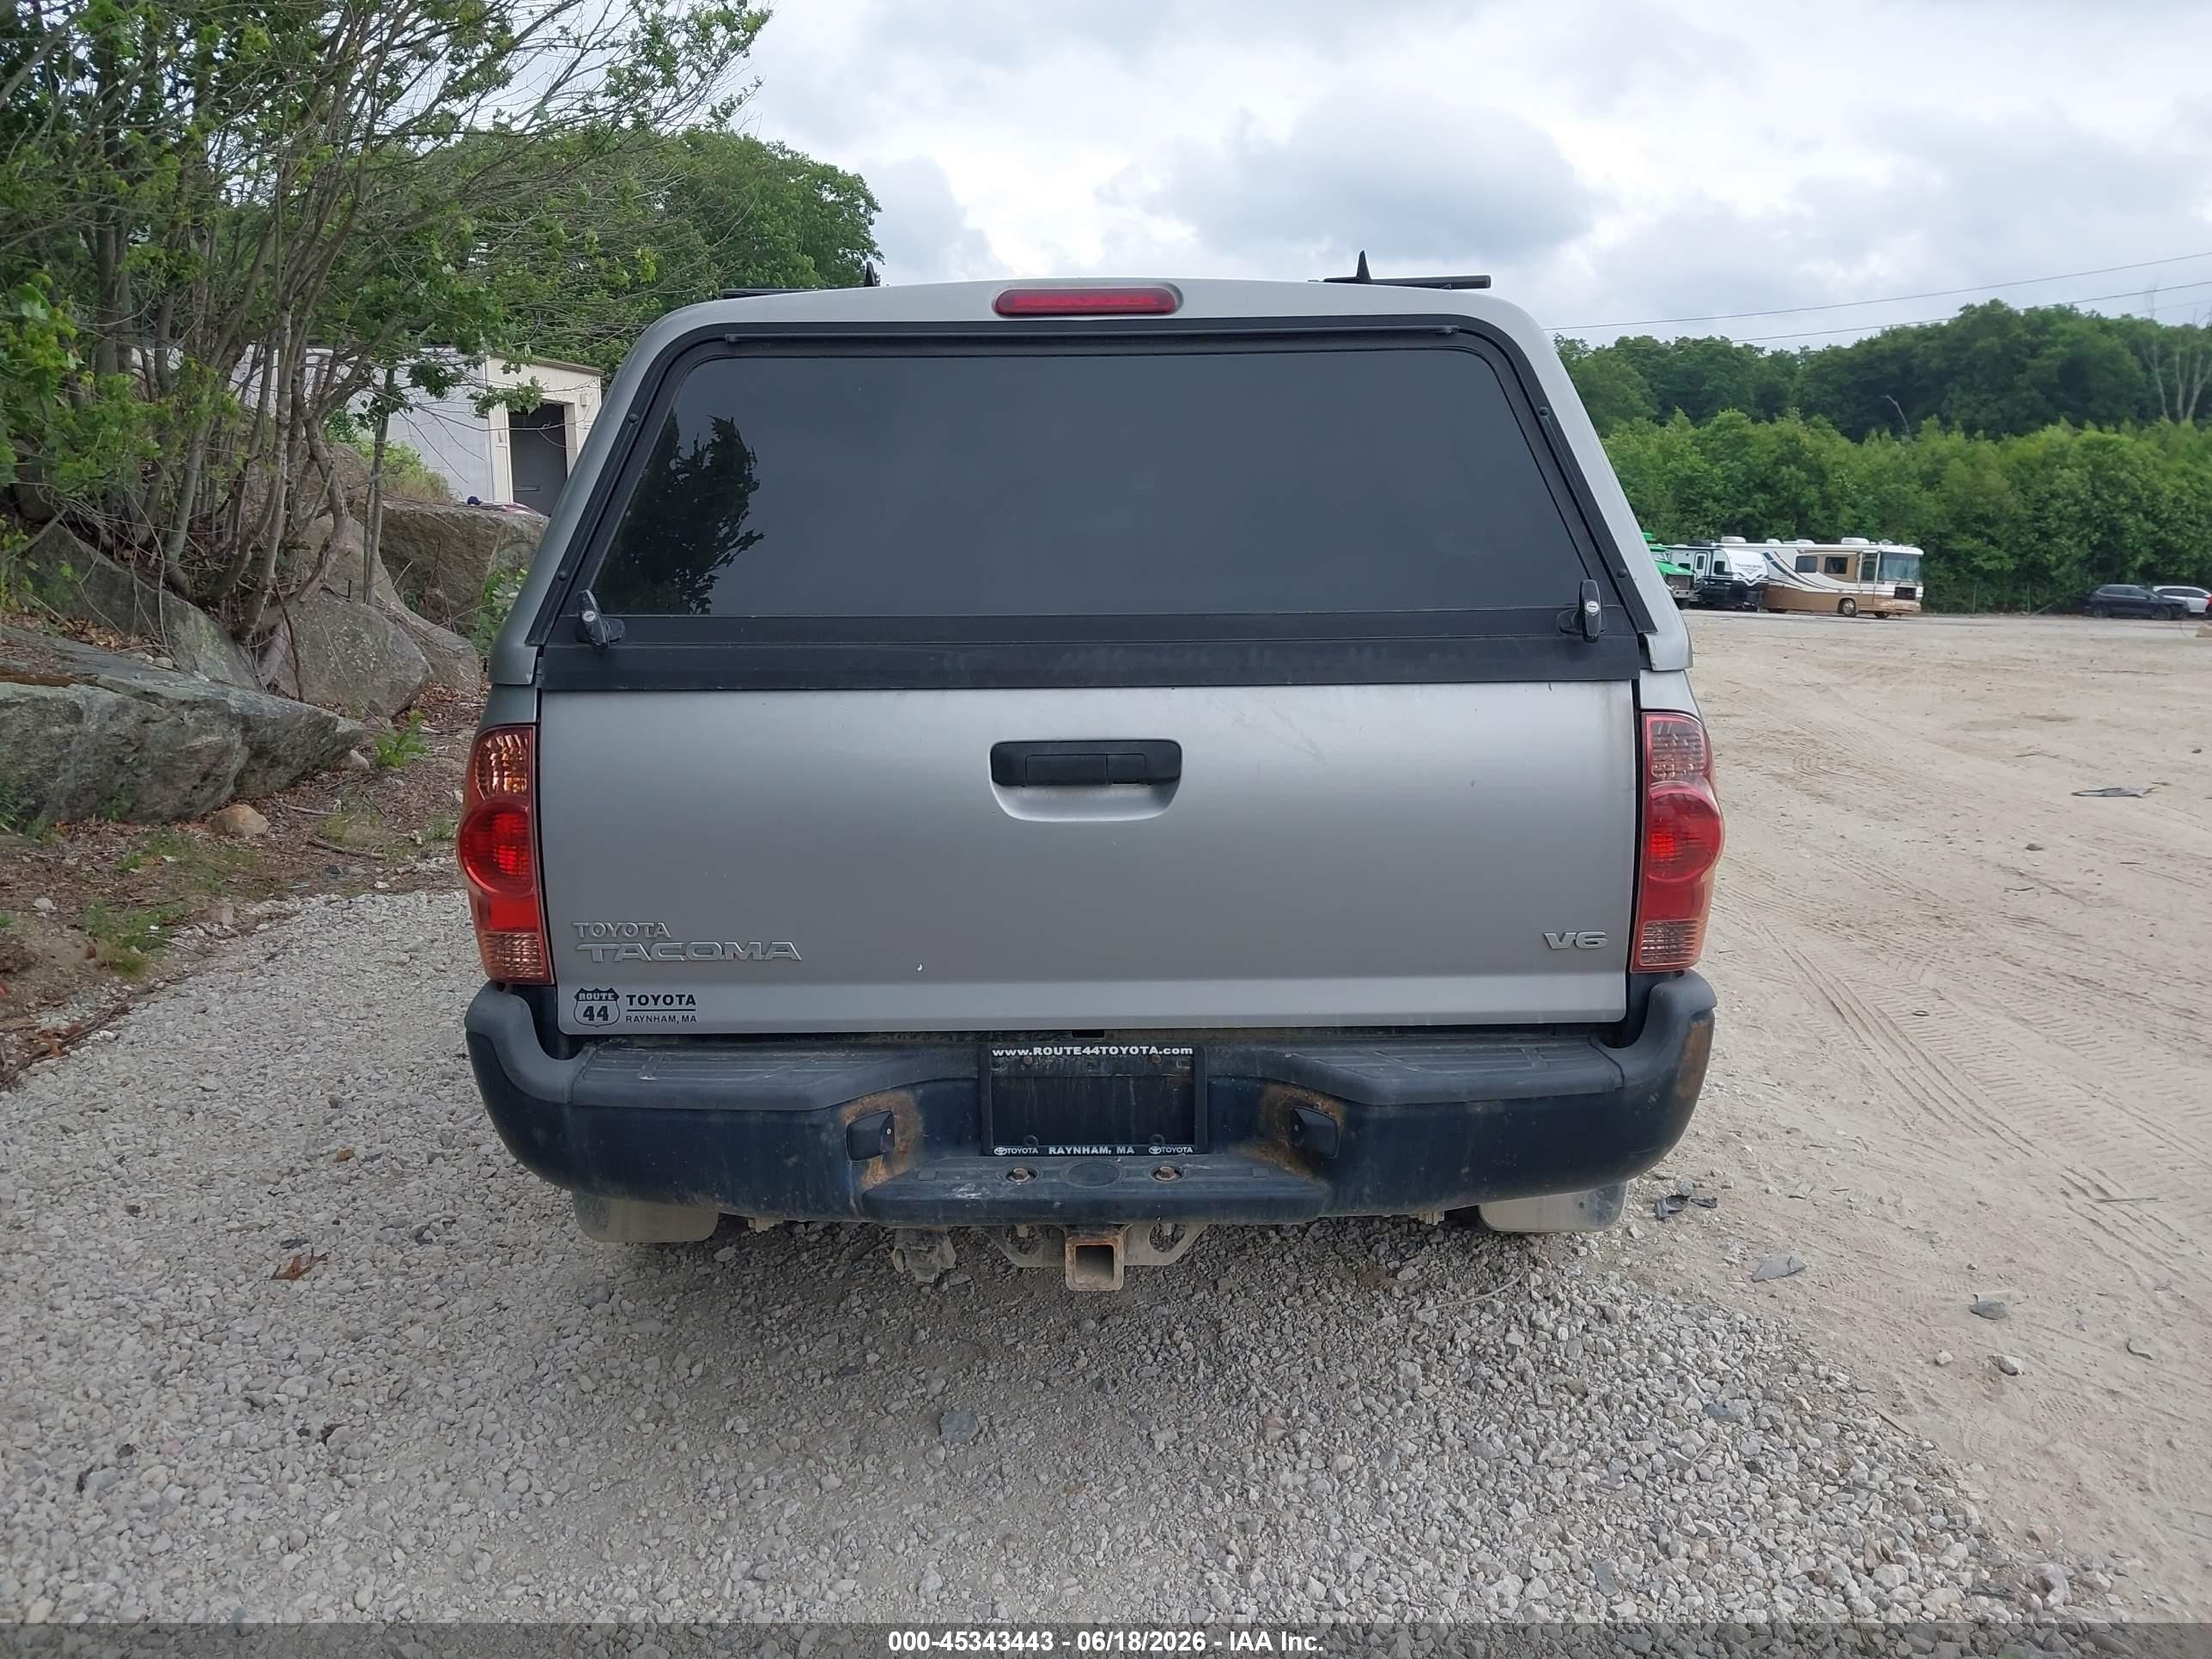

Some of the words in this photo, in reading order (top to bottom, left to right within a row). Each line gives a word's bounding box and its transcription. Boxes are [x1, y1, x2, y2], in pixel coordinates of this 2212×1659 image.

[572, 921, 672, 939] TOYOTA
[1543, 931, 1607, 949] V6
[576, 942, 803, 962] TACOMA
[578, 992, 615, 1001] ROUTE
[626, 994, 696, 1006] TOYOTA
[582, 1006, 609, 1022] 44
[626, 1014, 680, 1024] RAYNHAM,
[681, 1014, 697, 1023] MA
[992, 1046, 1193, 1056] www.ROUTE44TOYOTA.com
[1006, 1146, 1039, 1155] TOYOTA
[1048, 1146, 1112, 1156] RAYNHAM,
[1116, 1146, 1135, 1154] MA
